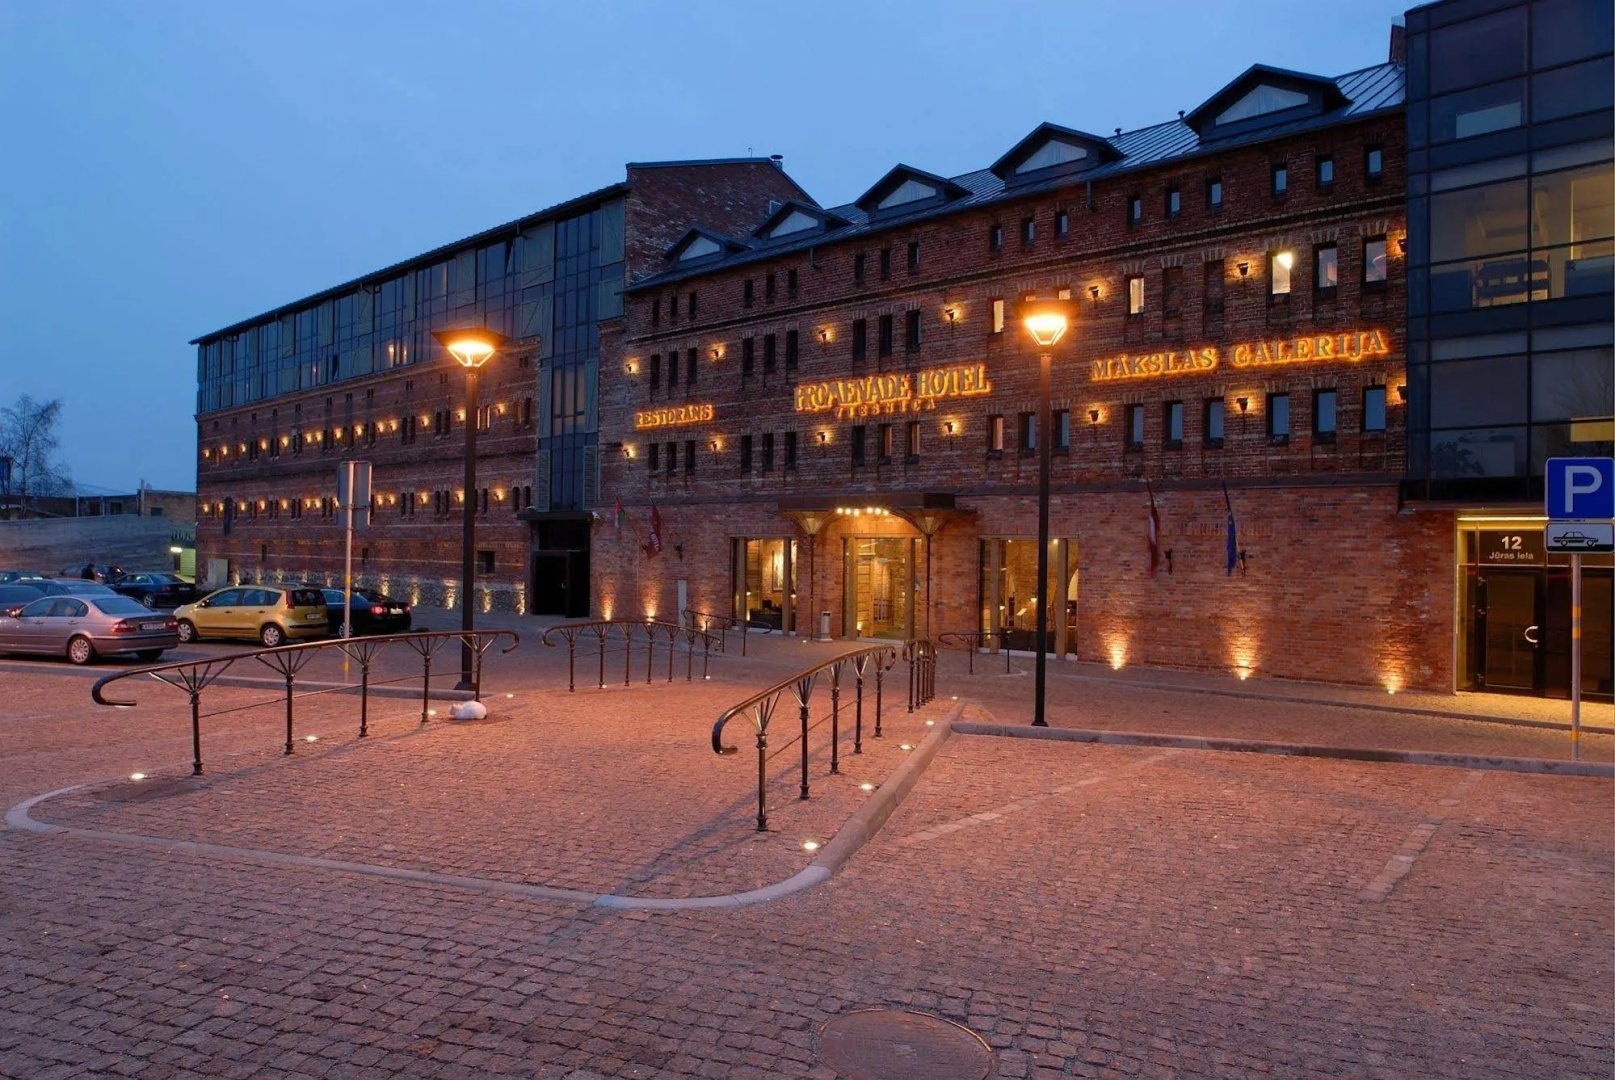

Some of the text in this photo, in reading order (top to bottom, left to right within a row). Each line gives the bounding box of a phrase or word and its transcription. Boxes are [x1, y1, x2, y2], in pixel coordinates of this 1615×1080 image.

[1228, 329, 1389, 367] GALERIJA
[916, 362, 991, 398] HOTEL
[1564, 465, 1603, 513] P
[1501, 535, 1522, 550] 12
